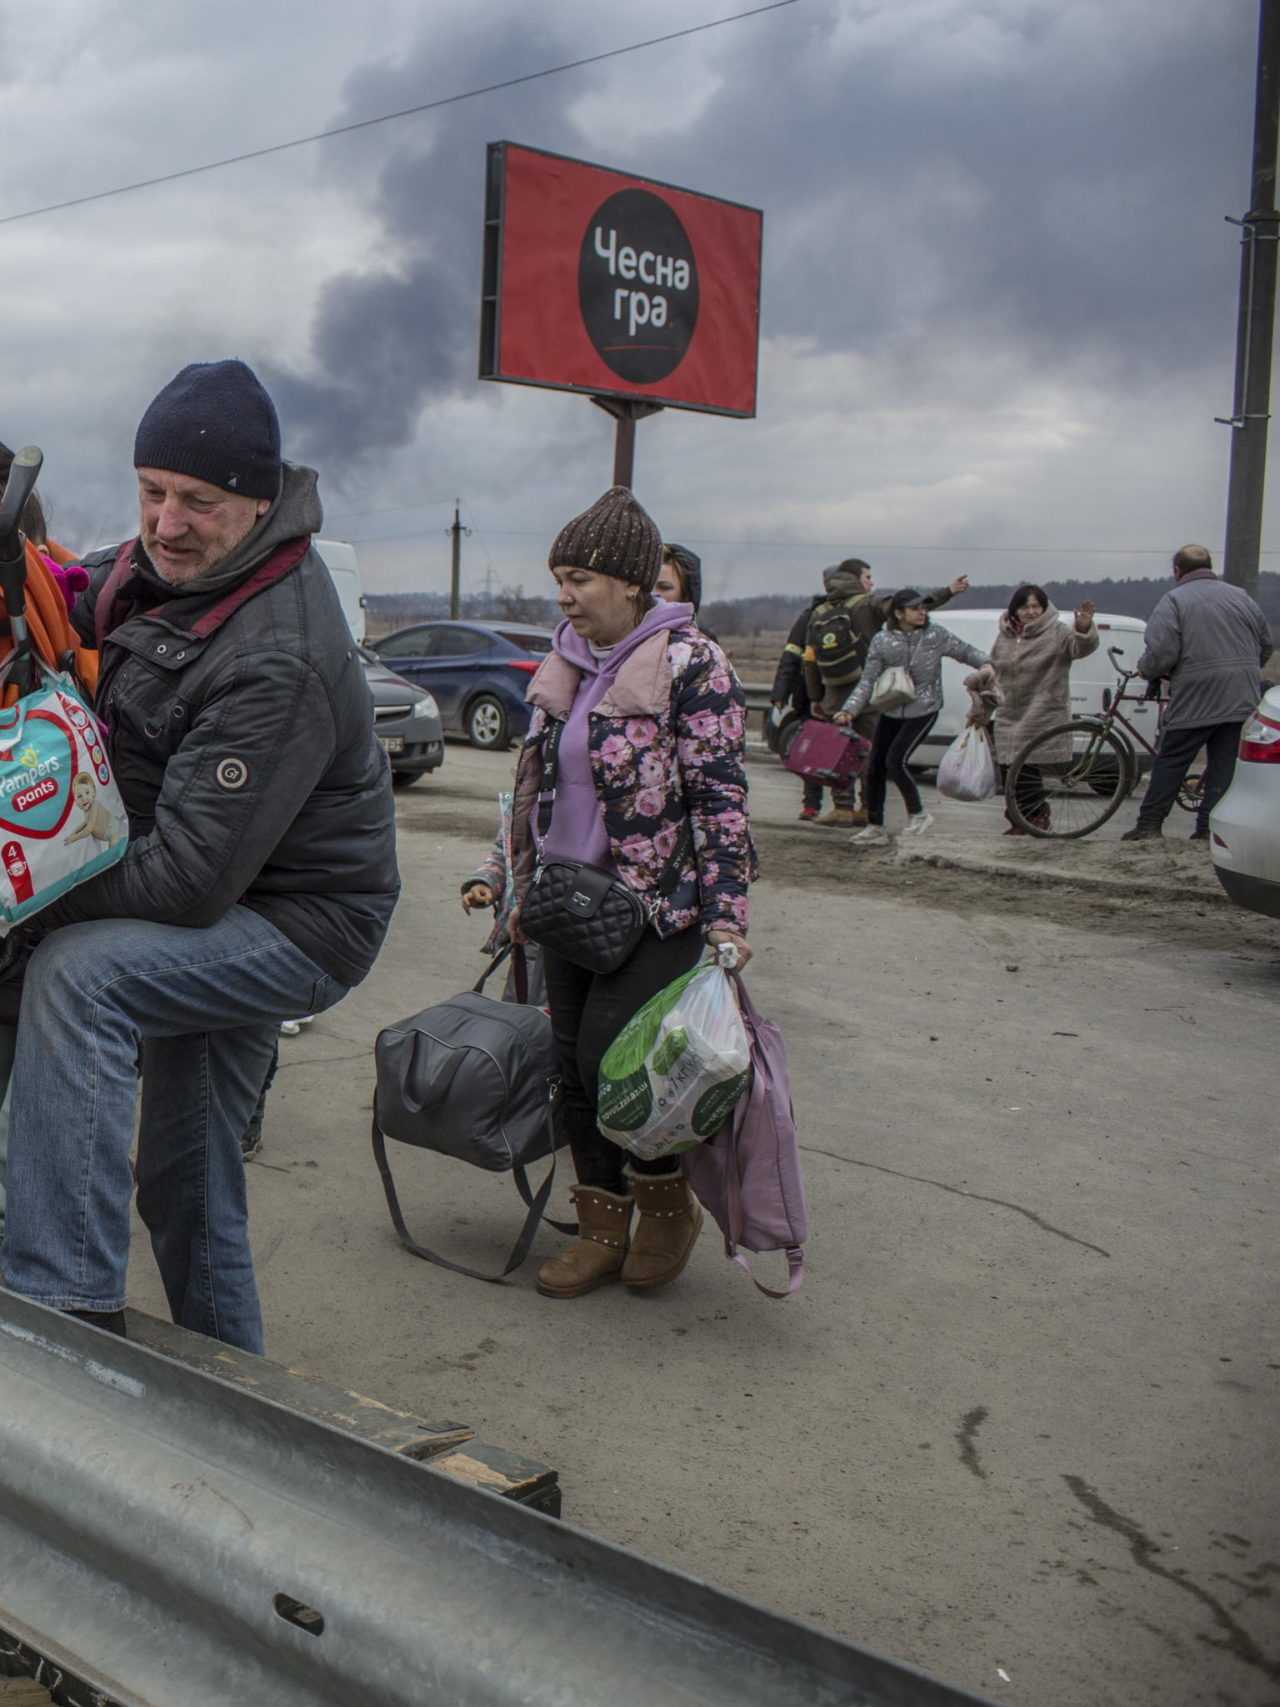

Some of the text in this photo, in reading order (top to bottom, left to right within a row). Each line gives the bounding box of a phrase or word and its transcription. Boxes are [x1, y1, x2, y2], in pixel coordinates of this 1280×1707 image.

[594, 226, 690, 291] Чесна
[614, 288, 668, 337] гра
[16, 779, 55, 811] pants
[7, 845, 18, 858] 4
